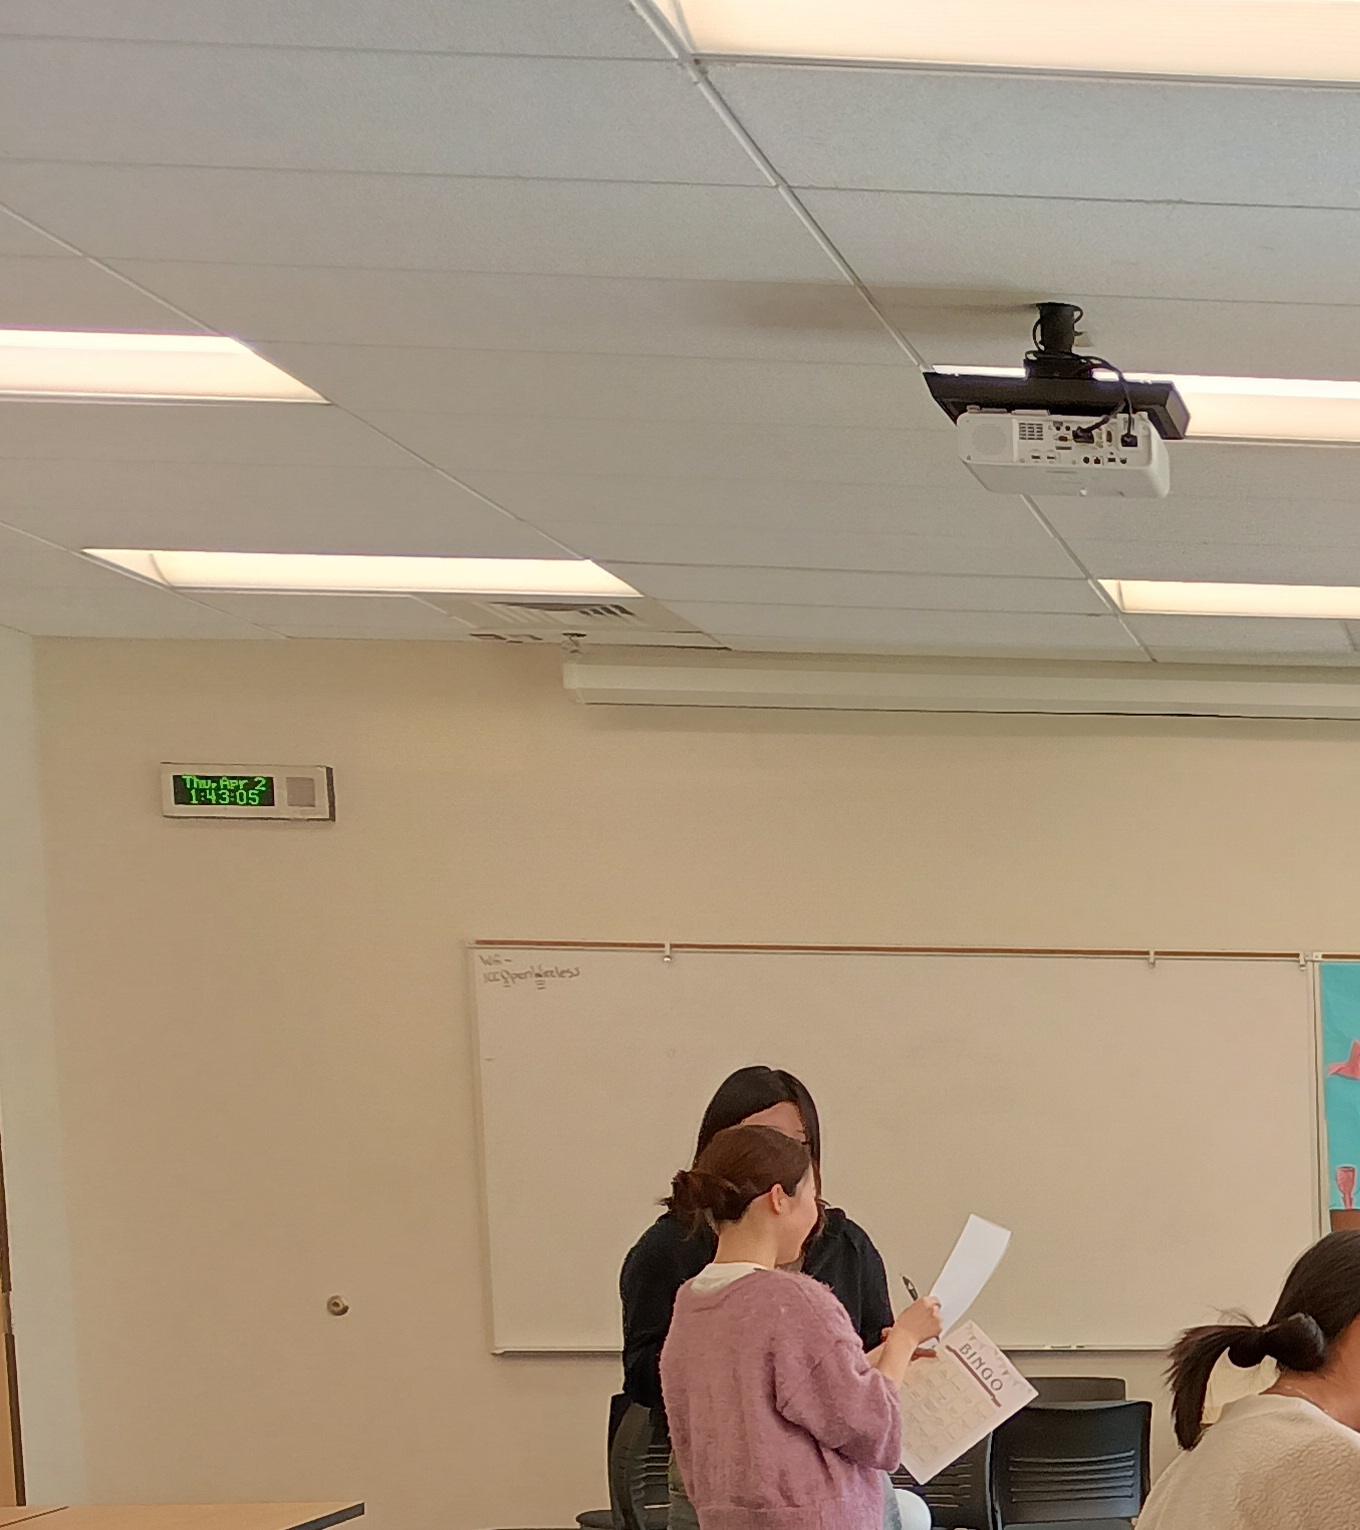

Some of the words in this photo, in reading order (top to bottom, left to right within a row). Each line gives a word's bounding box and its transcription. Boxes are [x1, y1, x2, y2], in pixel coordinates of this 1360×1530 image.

[254, 777, 267, 790] 2
[190, 789, 260, 805] 1:43:05
[959, 1343, 1004, 1391] BINGO
